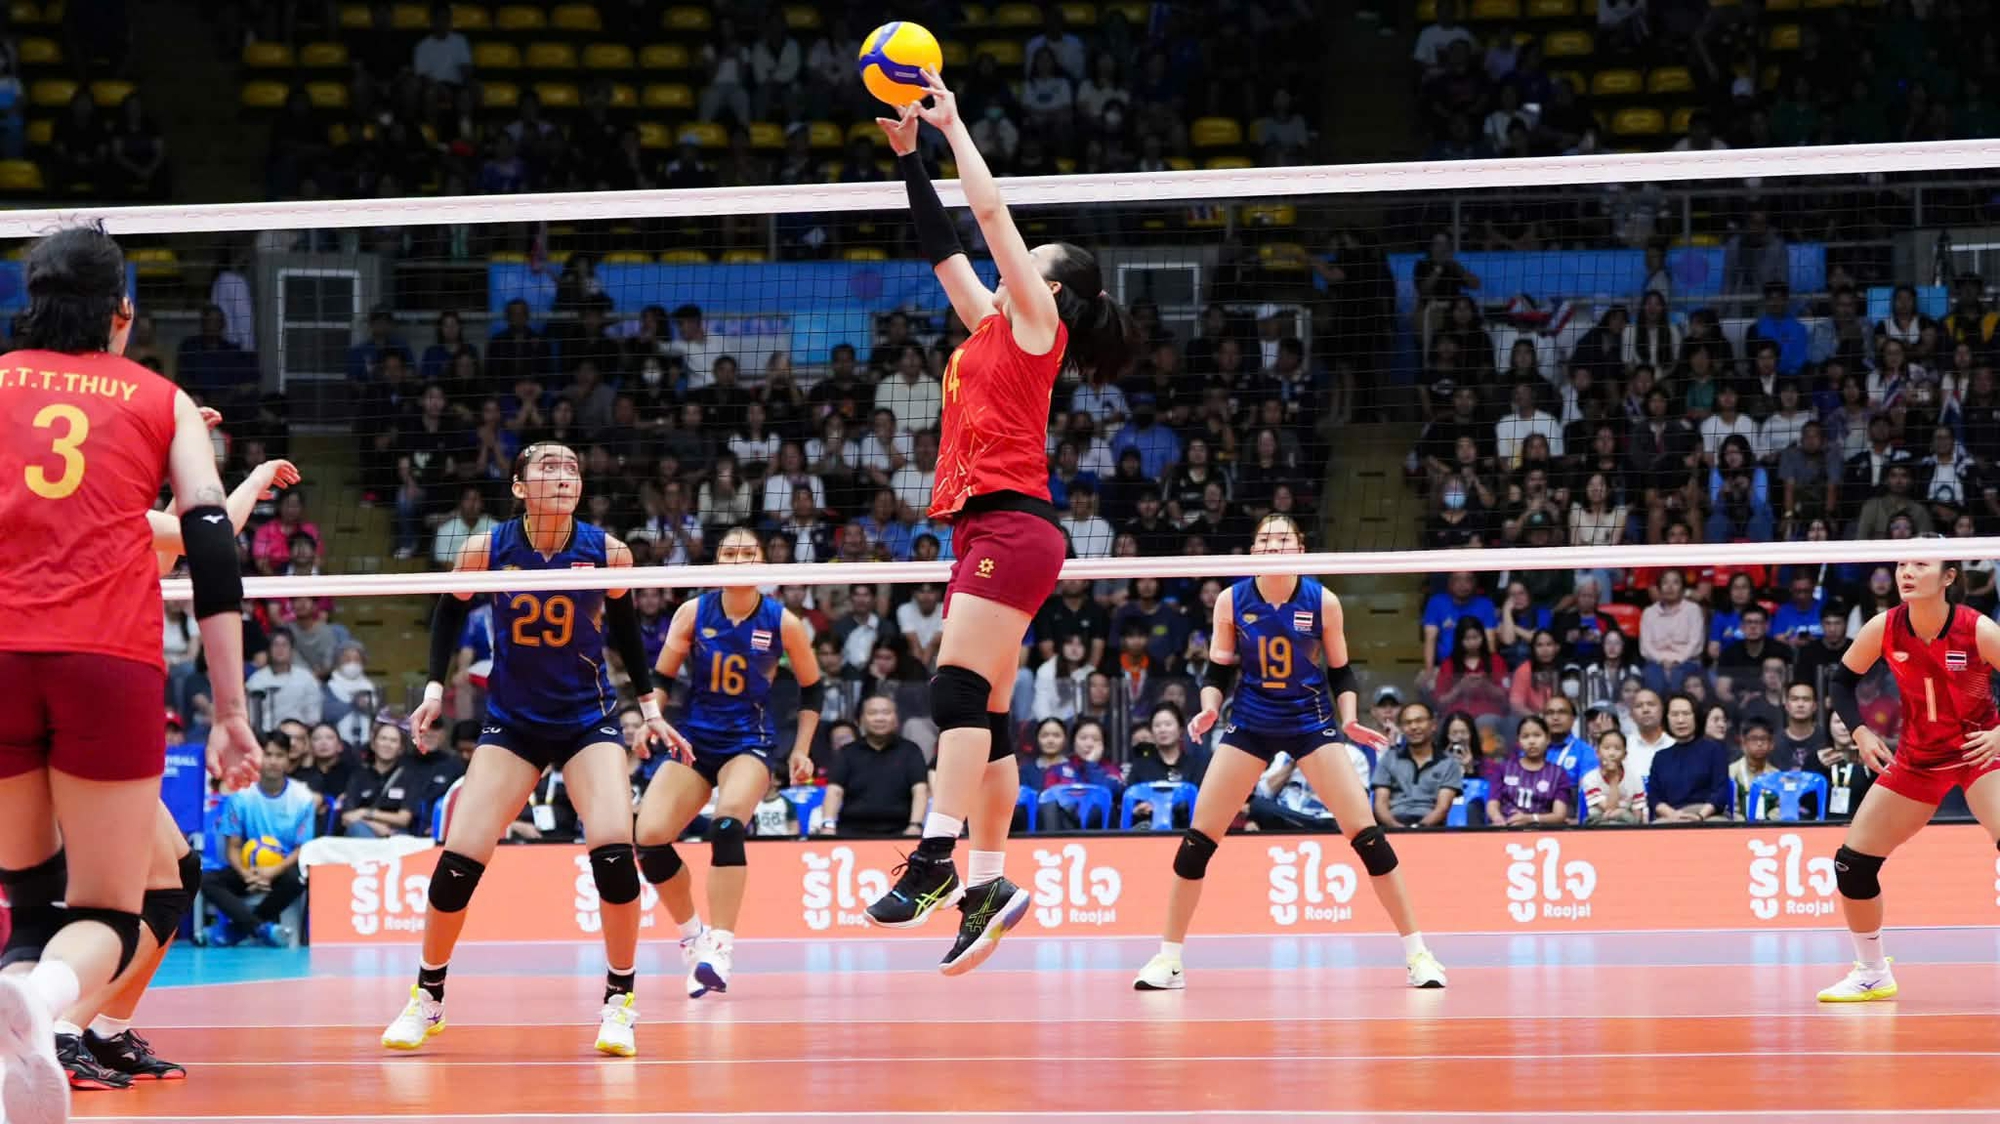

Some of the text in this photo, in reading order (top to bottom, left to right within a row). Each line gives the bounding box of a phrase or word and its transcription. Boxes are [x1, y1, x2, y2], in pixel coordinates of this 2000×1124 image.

[24, 403, 89, 499] 3
[510, 593, 575, 647] 29
[711, 650, 747, 696] 16
[1258, 635, 1292, 679] 19
[1923, 677, 1937, 723] 1
[1033, 843, 1121, 929] รู้ใจ
[1267, 840, 1357, 926] รู้ใจ
[1505, 837, 1597, 923] รู้ใจ
[1747, 833, 1838, 920] รู้ใจ
[1543, 902, 1591, 921] Roojai
[1786, 899, 1835, 917] Roojai
